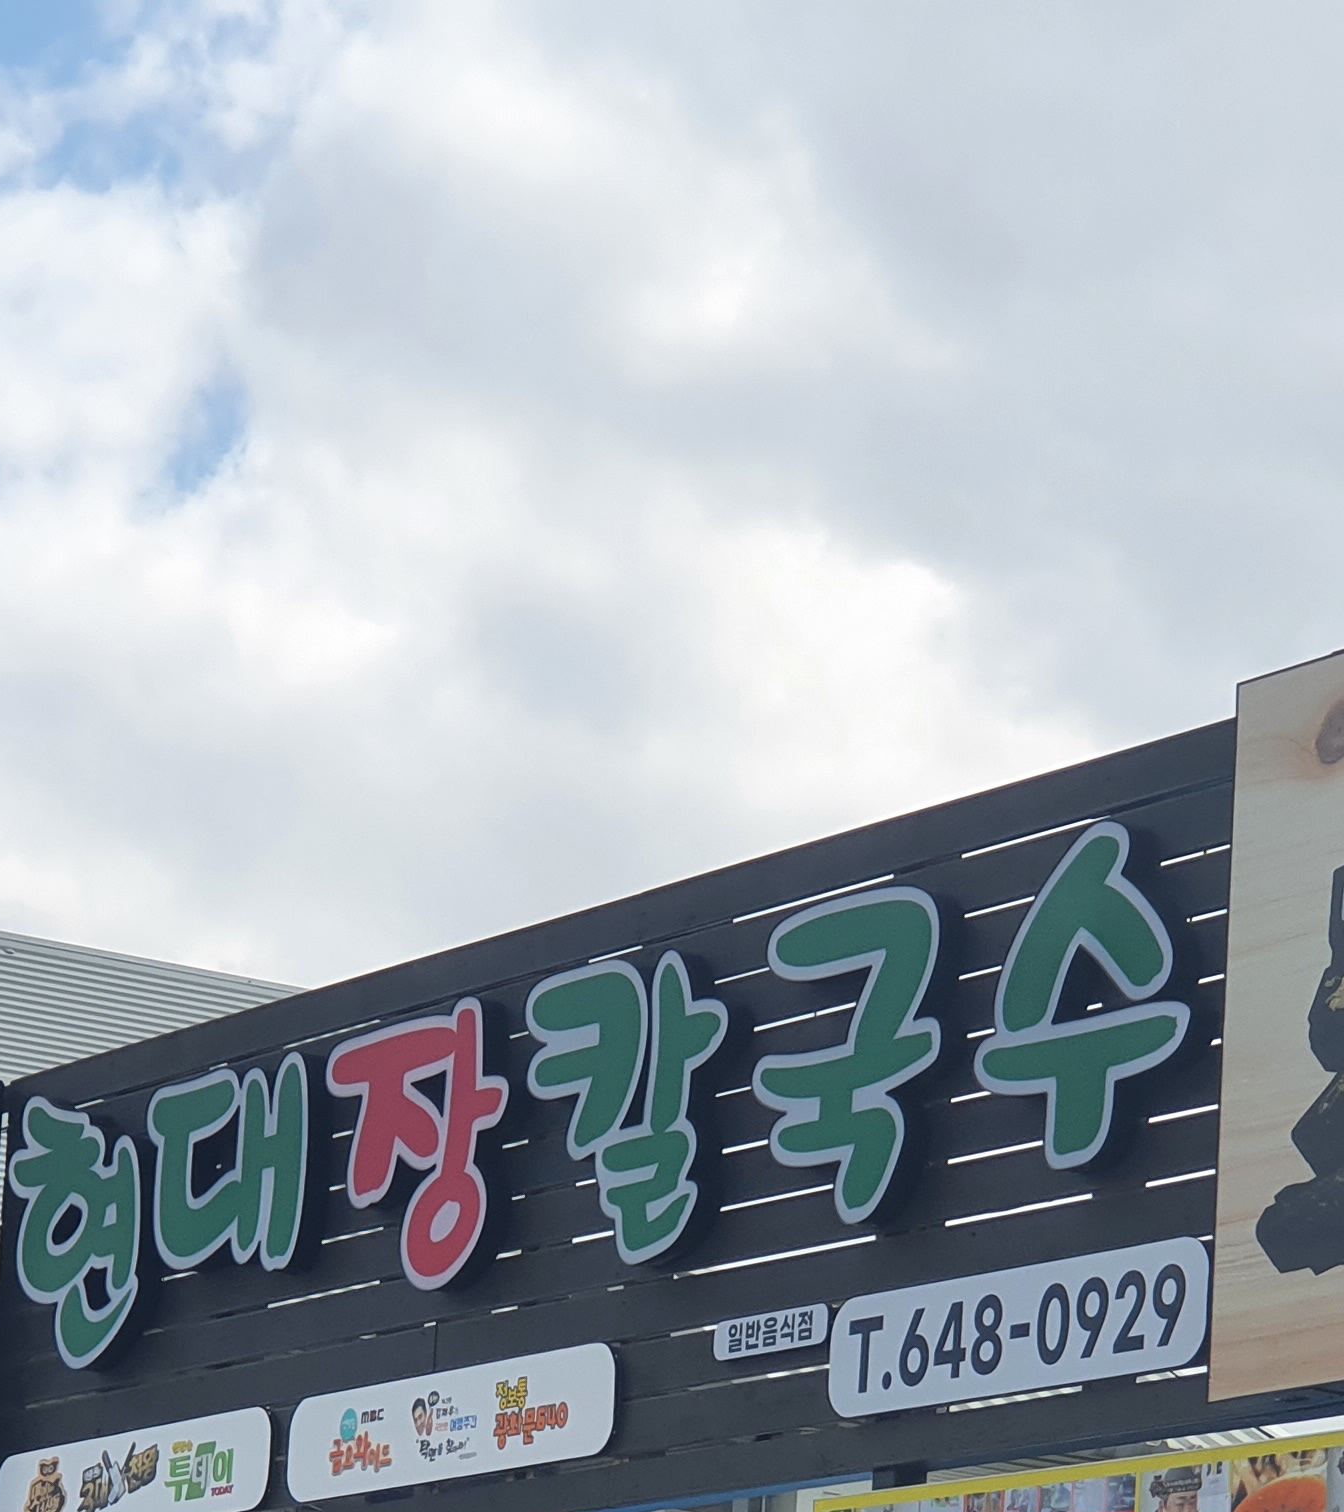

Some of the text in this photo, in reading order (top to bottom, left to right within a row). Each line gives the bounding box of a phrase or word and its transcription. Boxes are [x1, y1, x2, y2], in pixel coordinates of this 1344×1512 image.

[726, 1309, 814, 1354] 일반음식점
[848, 1263, 1188, 1395] T.648-0929
[496, 1376, 528, 1410] 정보통
[360, 1408, 385, 1425] MBC
[164, 1441, 234, 1502] 투데이
[210, 1484, 234, 1497] TODAY
